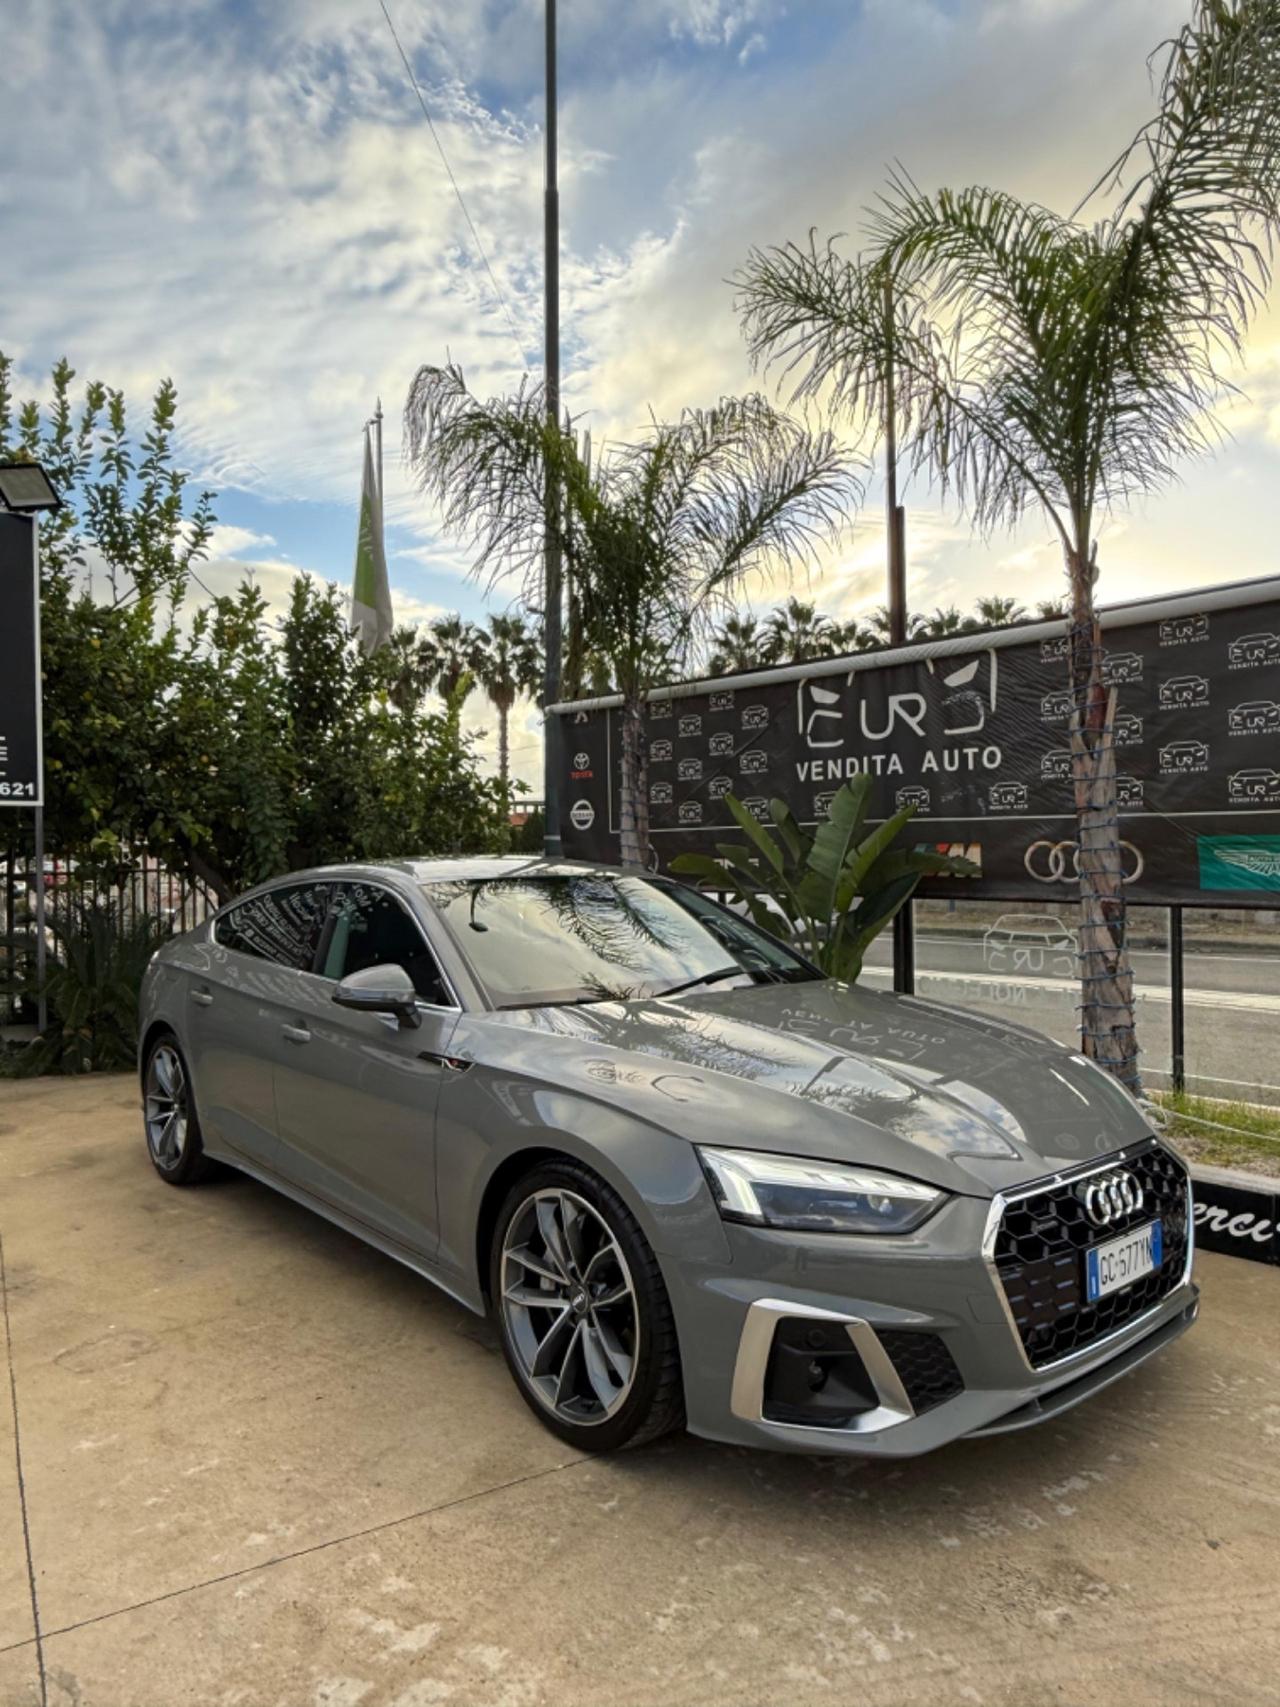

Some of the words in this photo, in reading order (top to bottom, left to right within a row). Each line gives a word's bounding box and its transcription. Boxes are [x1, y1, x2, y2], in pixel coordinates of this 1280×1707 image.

[796, 753, 904, 782] VENDITA
[921, 746, 1002, 773] AUTO
[0, 782, 34, 796] 621
